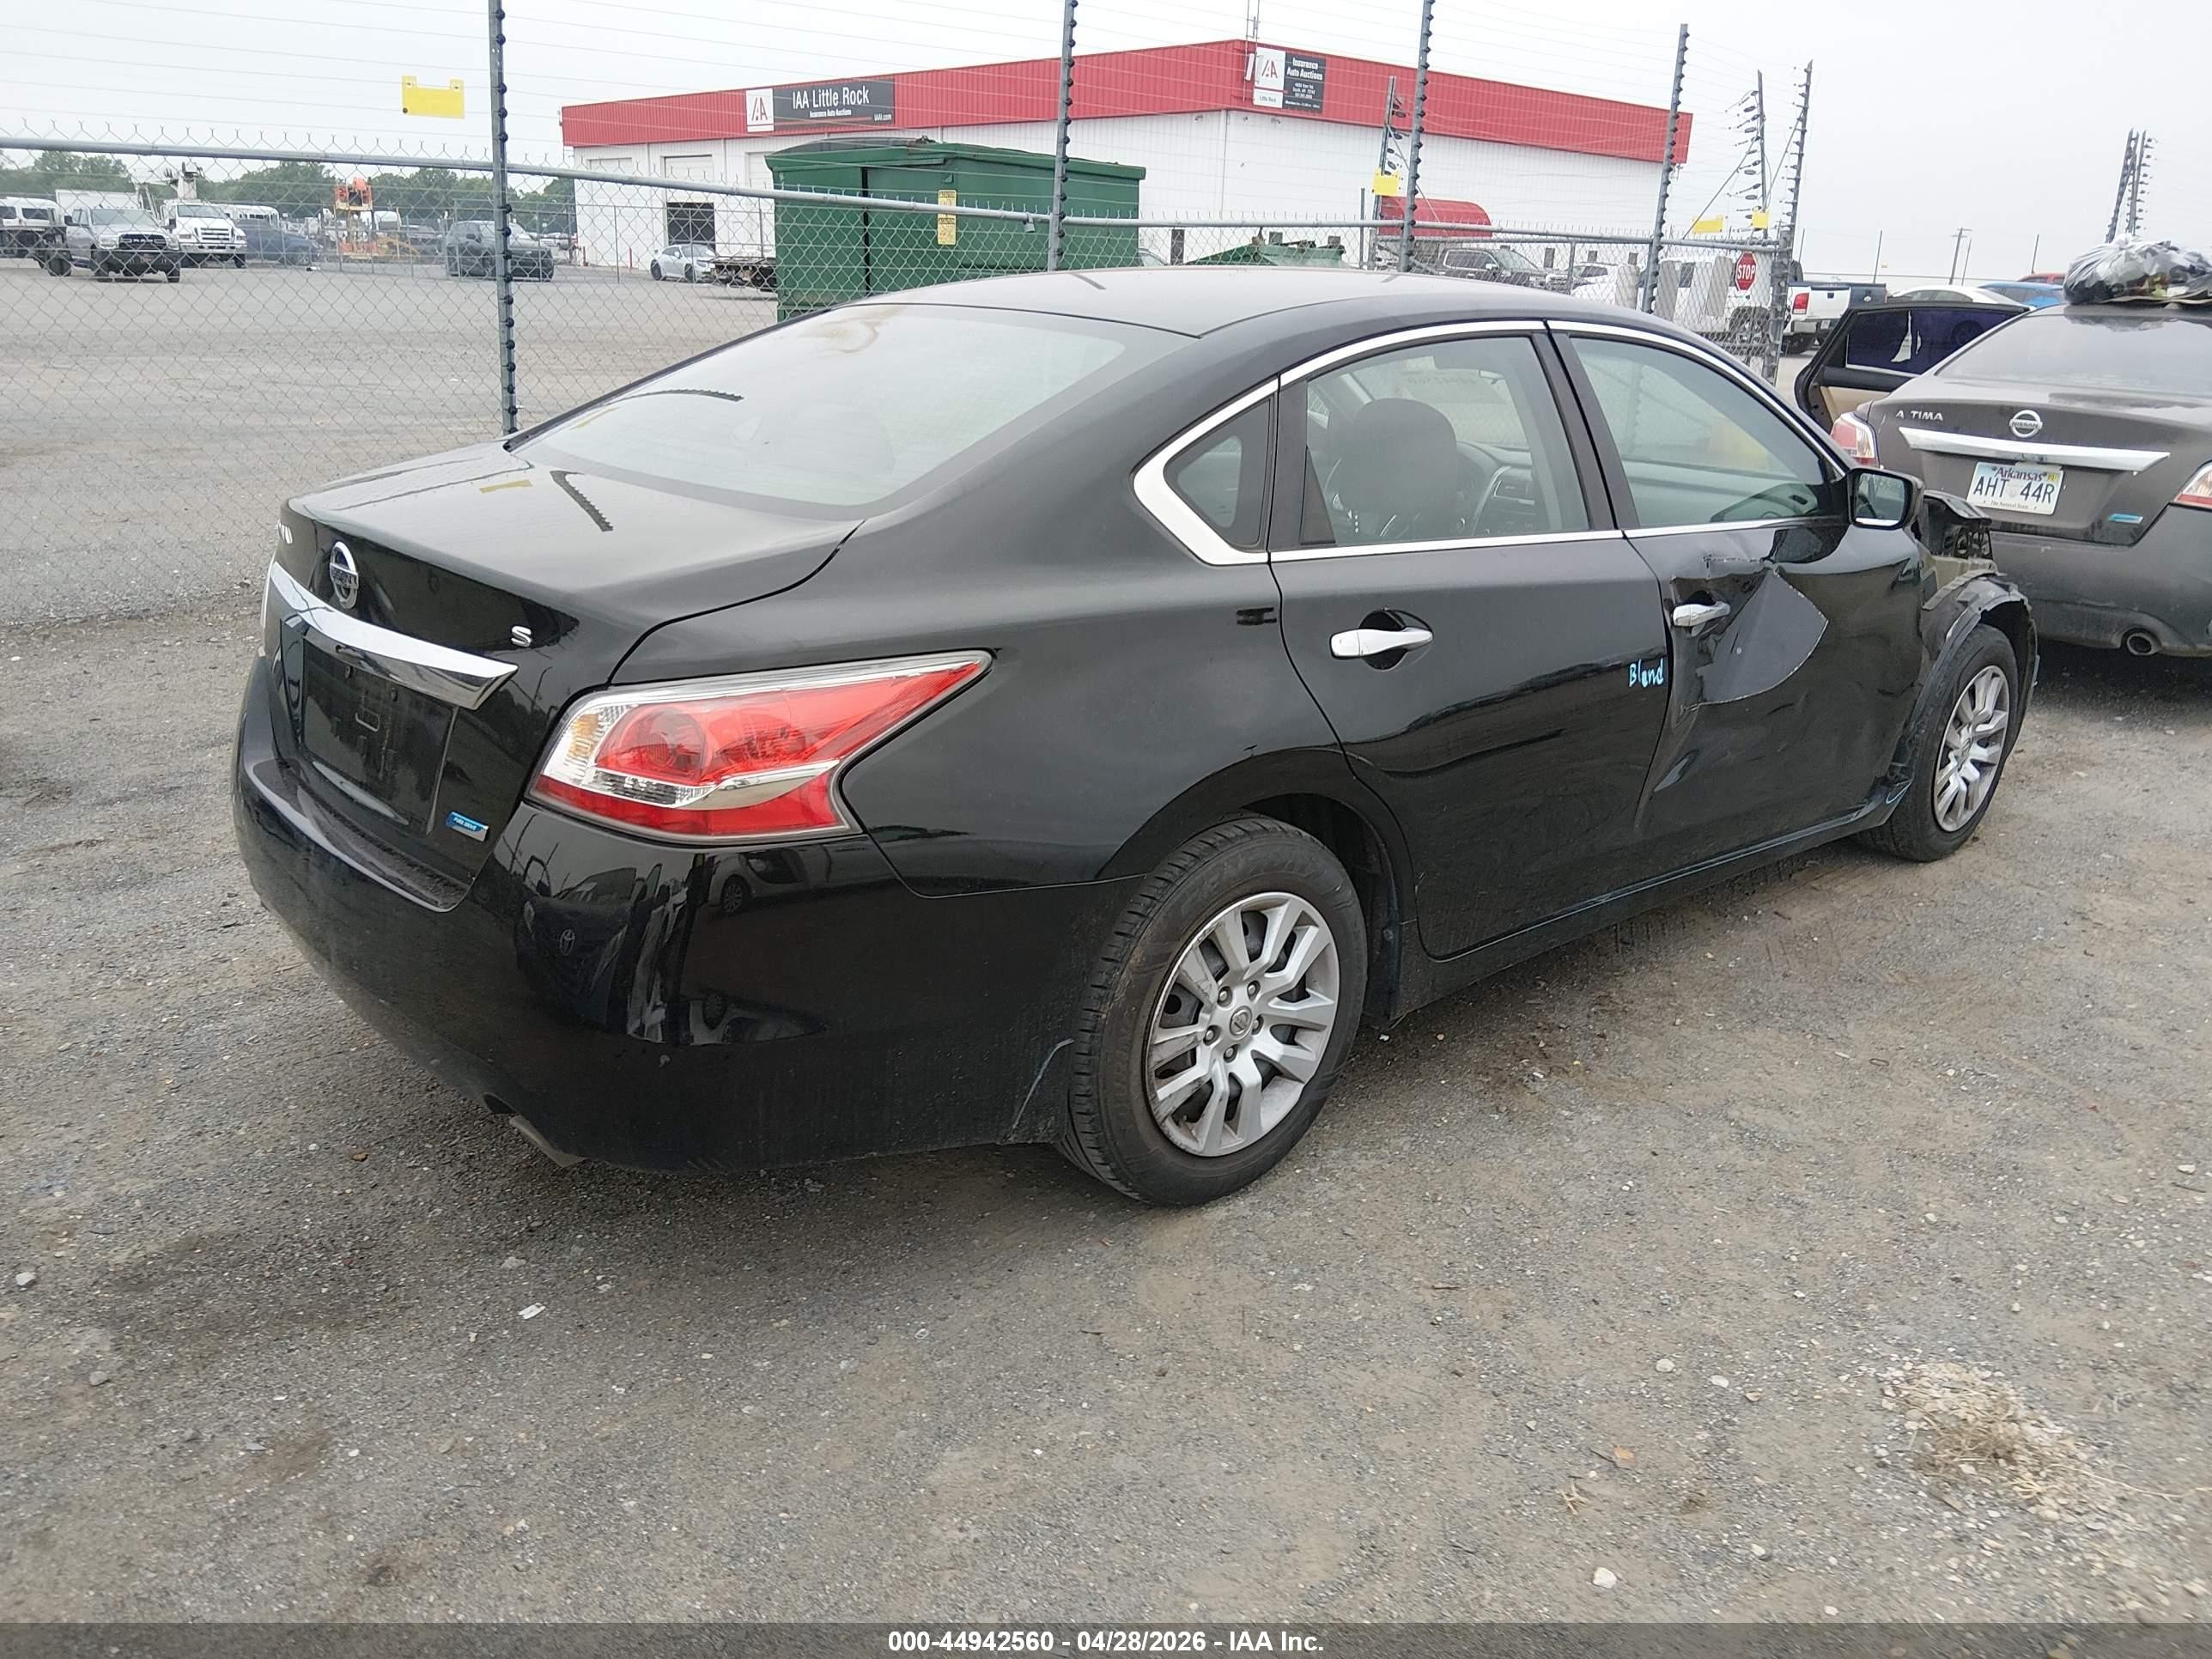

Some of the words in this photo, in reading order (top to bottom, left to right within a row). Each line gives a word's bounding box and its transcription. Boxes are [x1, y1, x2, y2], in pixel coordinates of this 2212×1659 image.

[1292, 57, 1319, 70] Insurance
[1286, 66, 1299, 76] Auto
[1299, 68, 1322, 81] Auctions
[793, 90, 809, 110] IAA
[812, 88, 839, 108] Little
[842, 85, 870, 106] Rock
[1737, 264, 1756, 281] STOP
[1994, 466, 2044, 482] Arkansas
[1972, 476, 2010, 498] AHT
[2019, 481, 2055, 504] 44R
[510, 625, 532, 647] S
